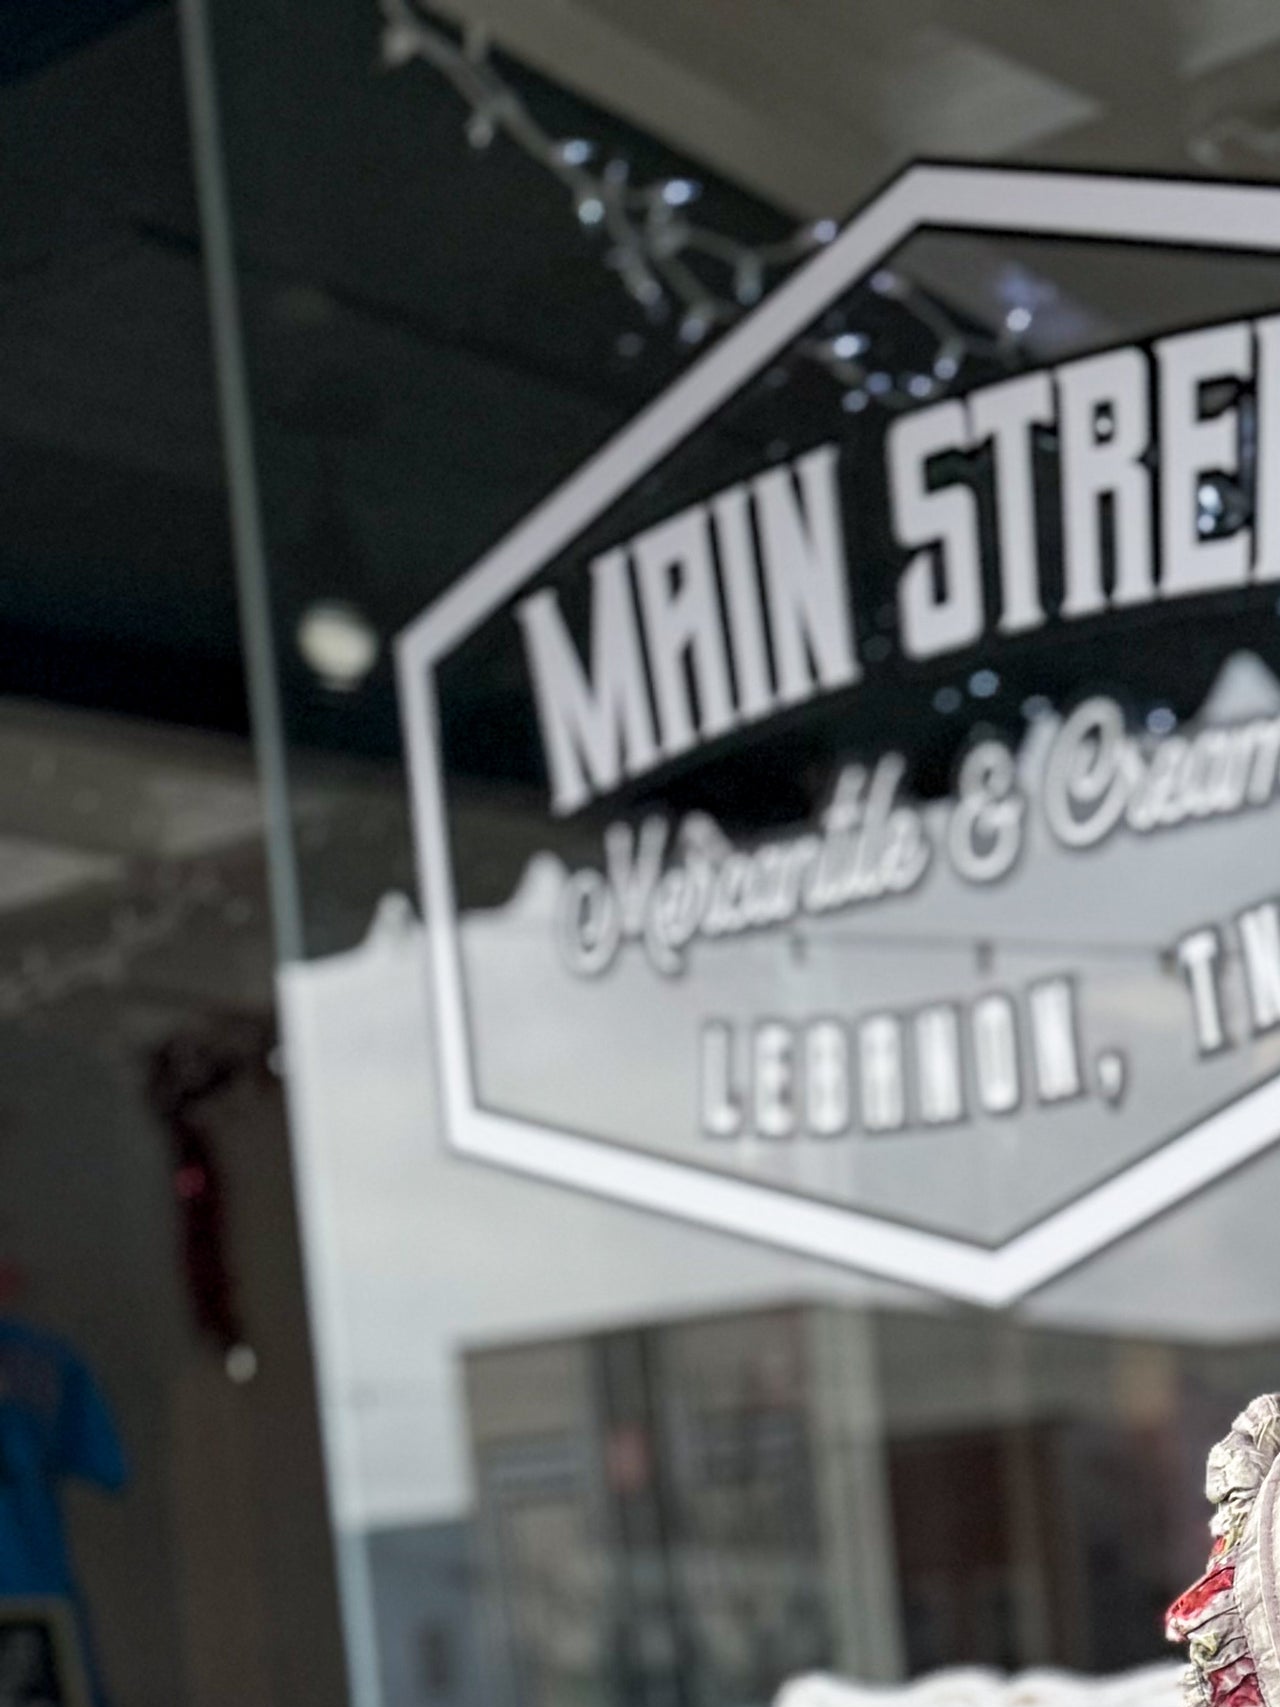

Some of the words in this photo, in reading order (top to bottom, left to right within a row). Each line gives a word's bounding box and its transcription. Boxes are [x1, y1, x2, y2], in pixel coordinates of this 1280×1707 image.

[513, 444, 863, 818] MAIN
[564, 750, 931, 978] Mercantile
[949, 740, 1024, 882] &
